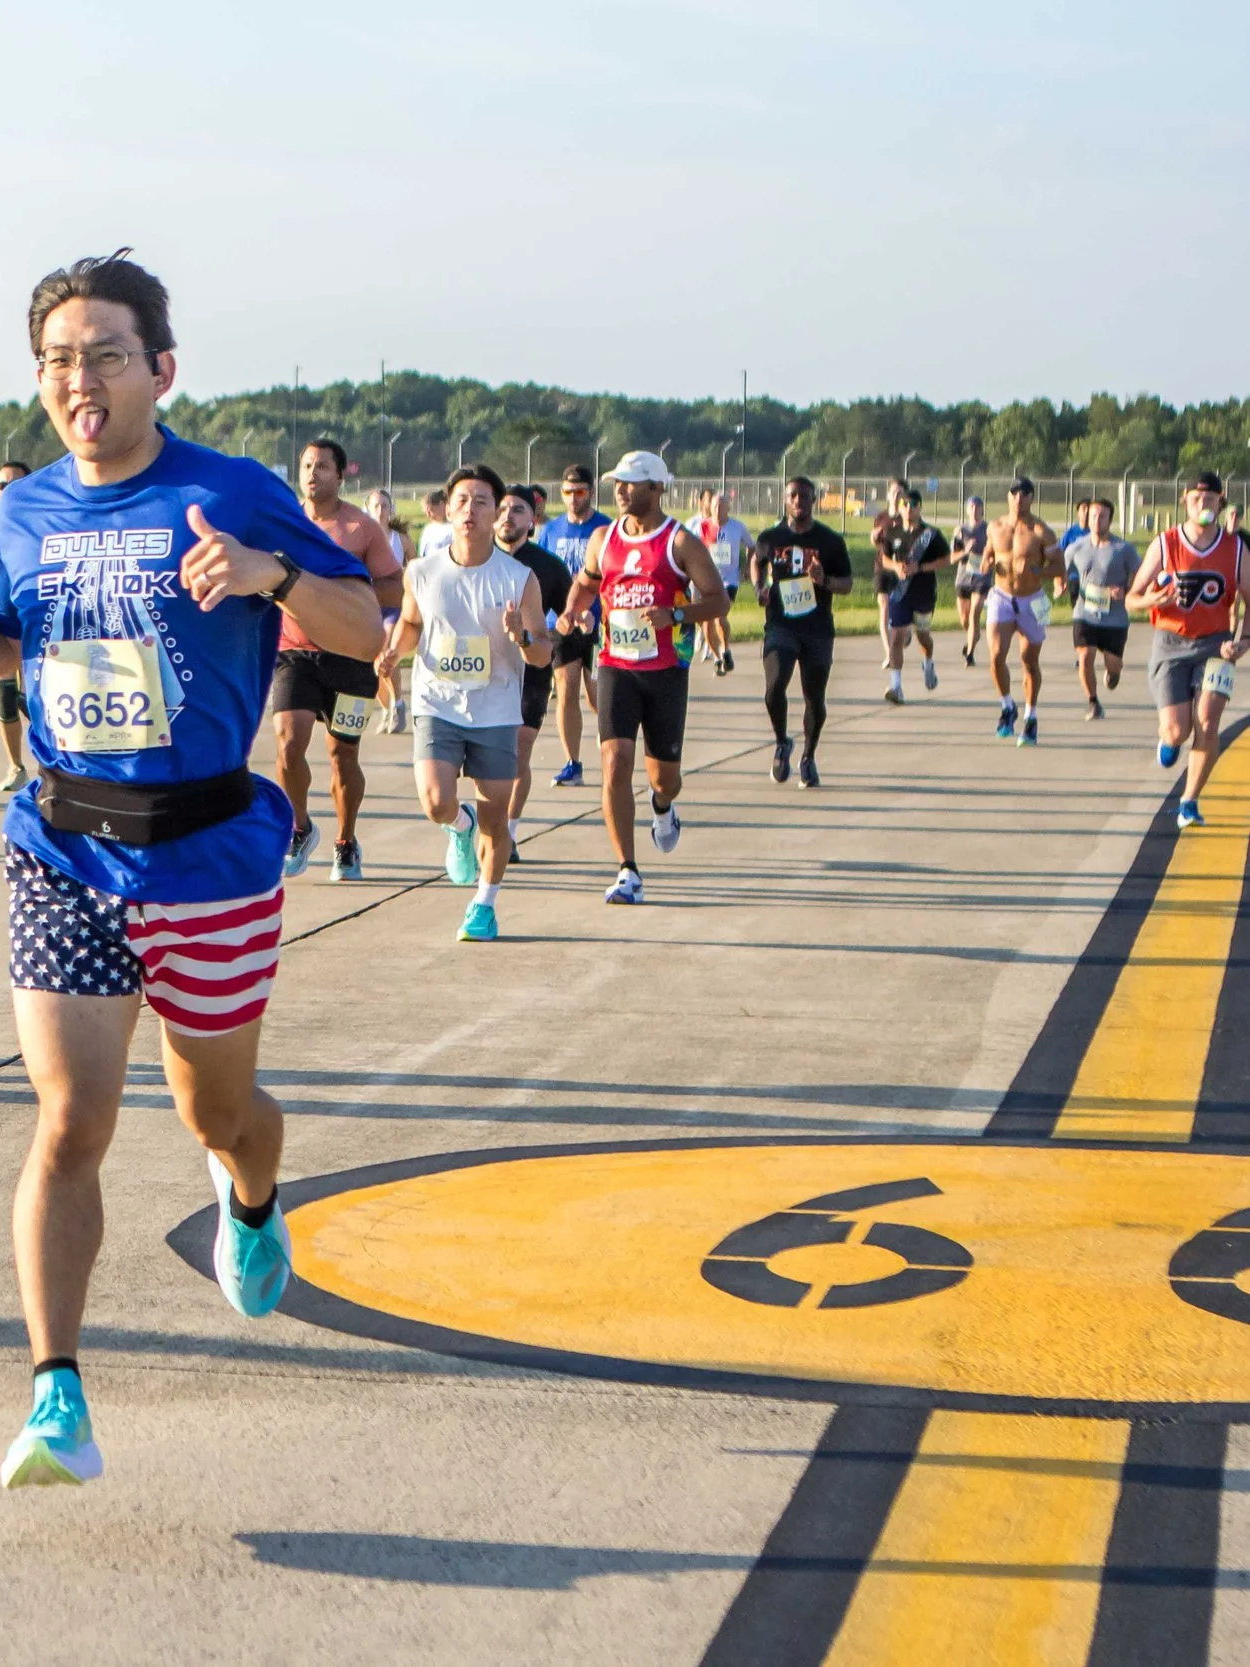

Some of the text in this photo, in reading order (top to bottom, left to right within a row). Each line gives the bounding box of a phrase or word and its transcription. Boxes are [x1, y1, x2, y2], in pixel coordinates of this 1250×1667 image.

[42, 530, 172, 563] DULLES
[111, 572, 177, 598] 10K
[613, 593, 654, 609] HERO
[613, 627, 650, 644] 3124
[440, 656, 485, 672] 3050
[57, 691, 154, 729] 3652
